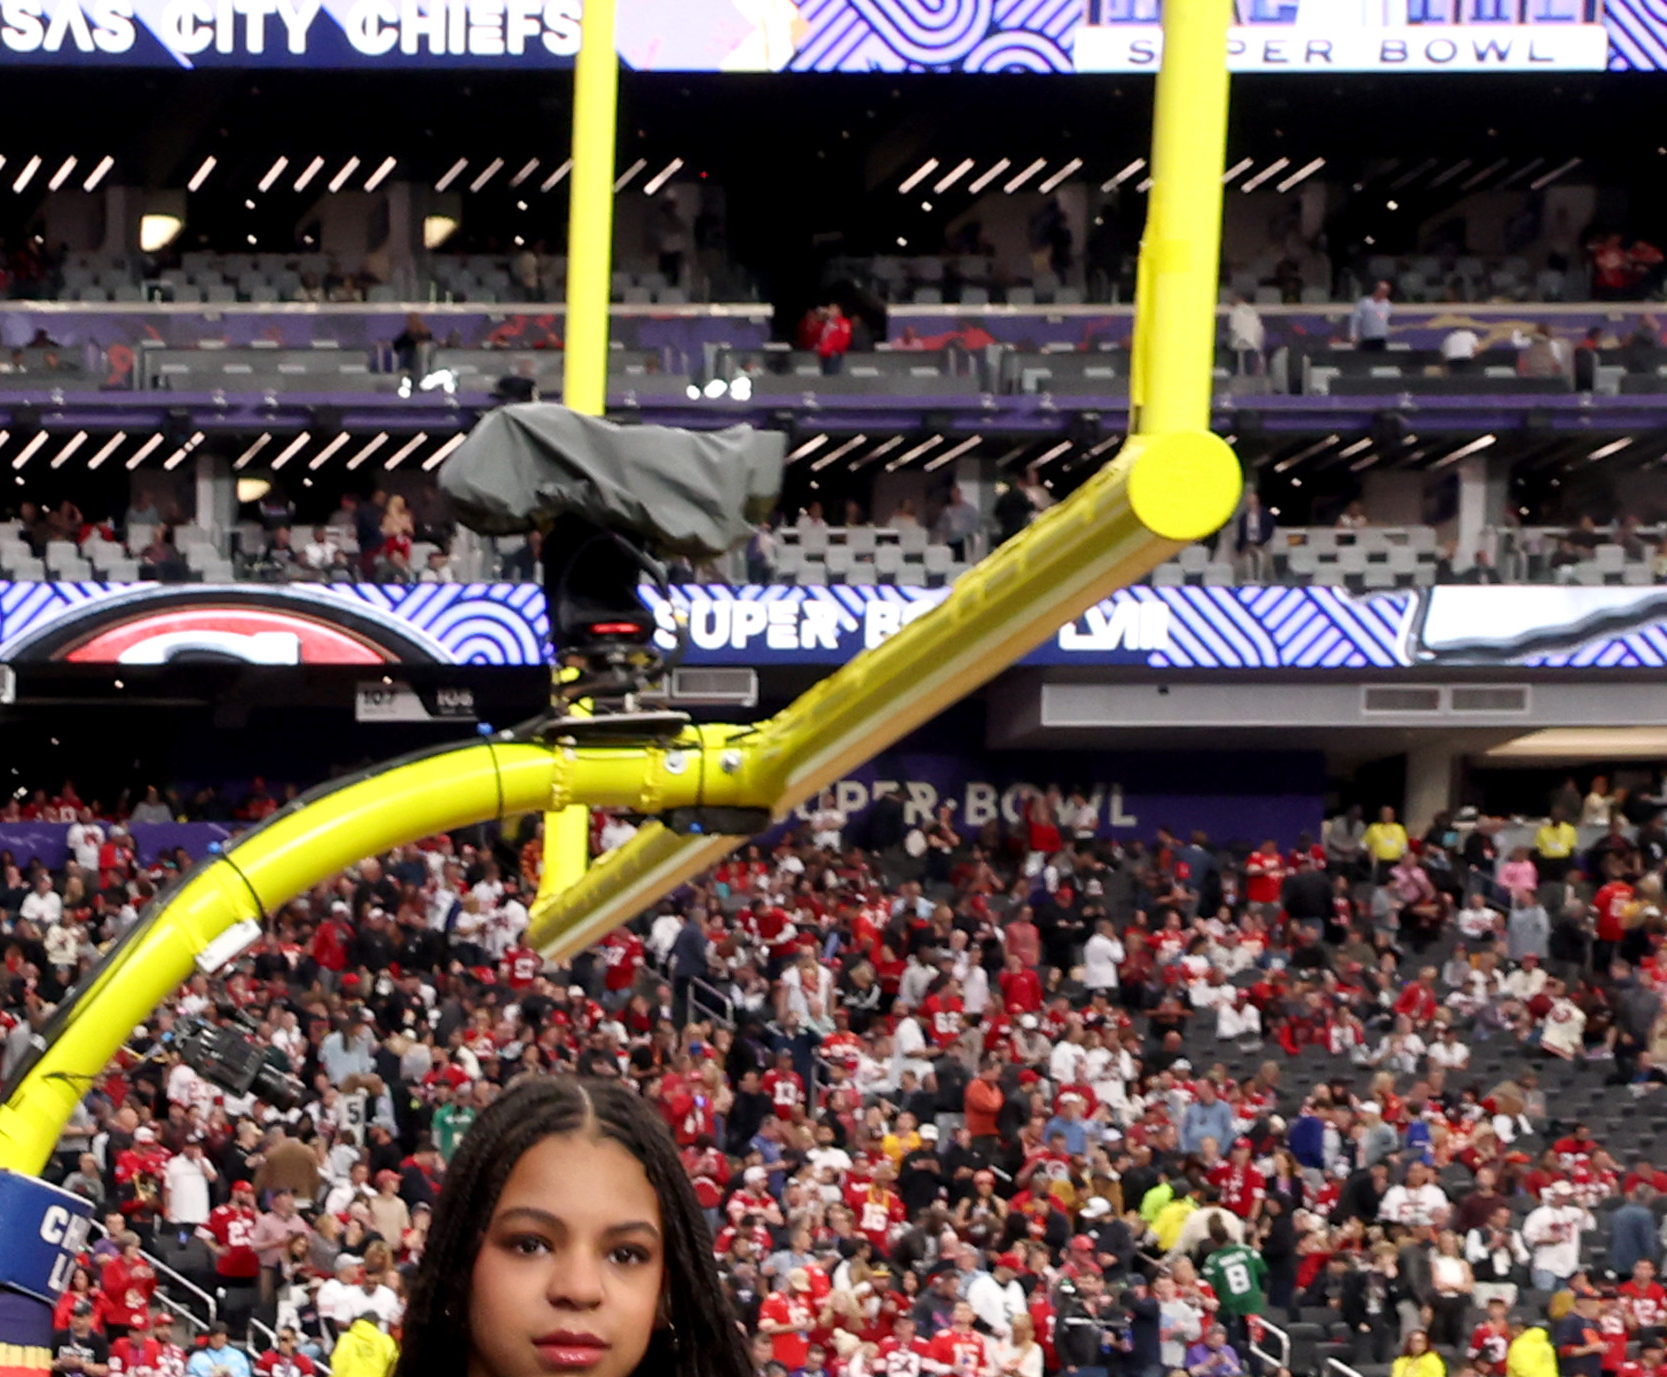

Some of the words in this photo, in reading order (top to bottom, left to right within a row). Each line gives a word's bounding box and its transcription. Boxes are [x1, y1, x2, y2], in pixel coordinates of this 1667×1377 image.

[161, 0, 322, 54] CITY
[346, 0, 582, 56] CHIEFS
[1127, 38, 1334, 64] SPER
[1378, 38, 1555, 64] BOWL
